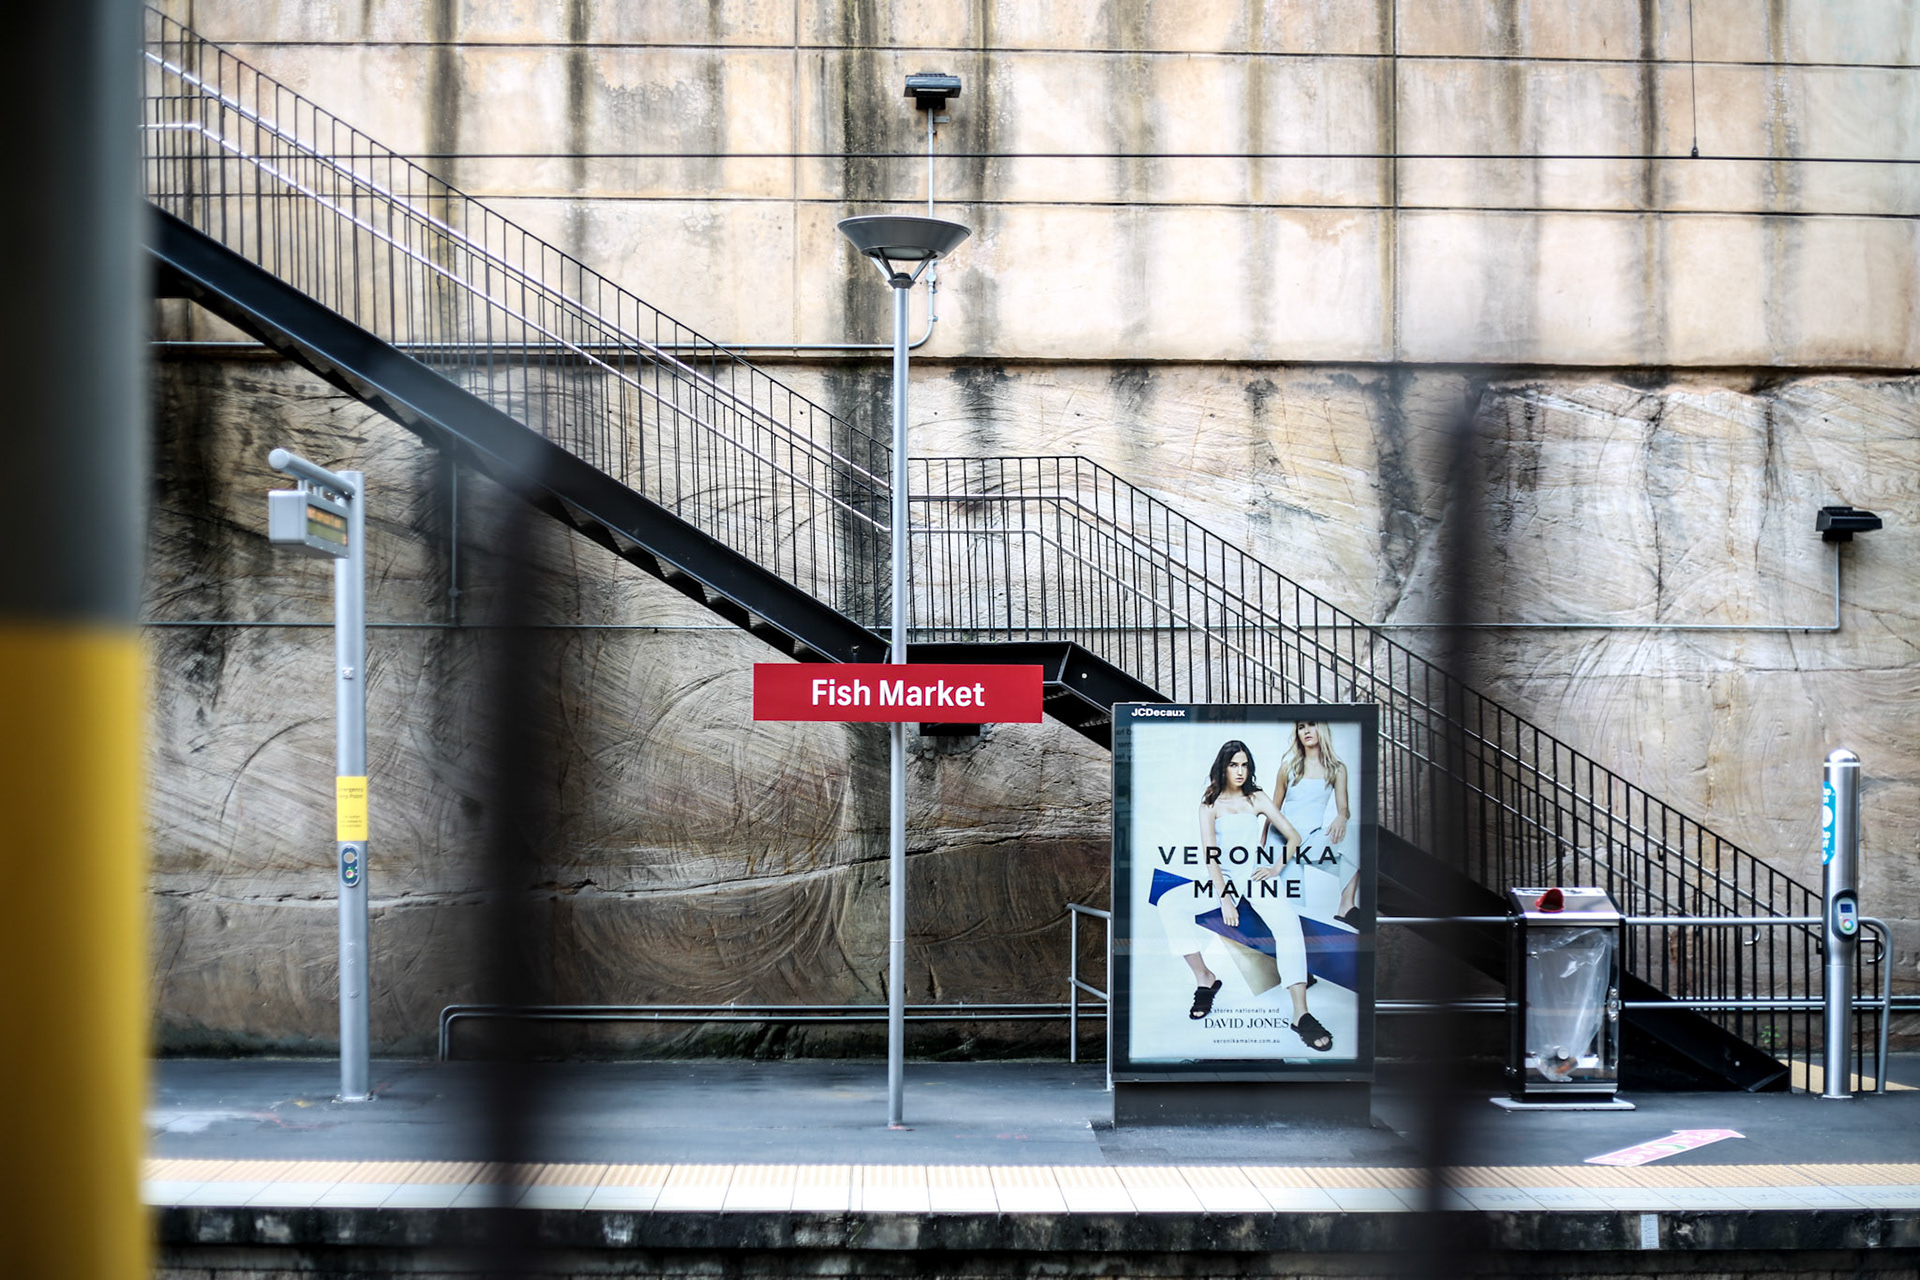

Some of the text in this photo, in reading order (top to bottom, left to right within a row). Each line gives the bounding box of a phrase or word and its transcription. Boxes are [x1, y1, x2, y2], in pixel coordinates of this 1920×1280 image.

[811, 678, 986, 707] Fish Market
[1131, 707, 1186, 717] JCDecaux
[1158, 846, 1338, 865] VERONIKA
[1194, 880, 1301, 898] MAINE
[1235, 1007, 1266, 1015] nationally
[1204, 1018, 1290, 1029] DAVID JONES
